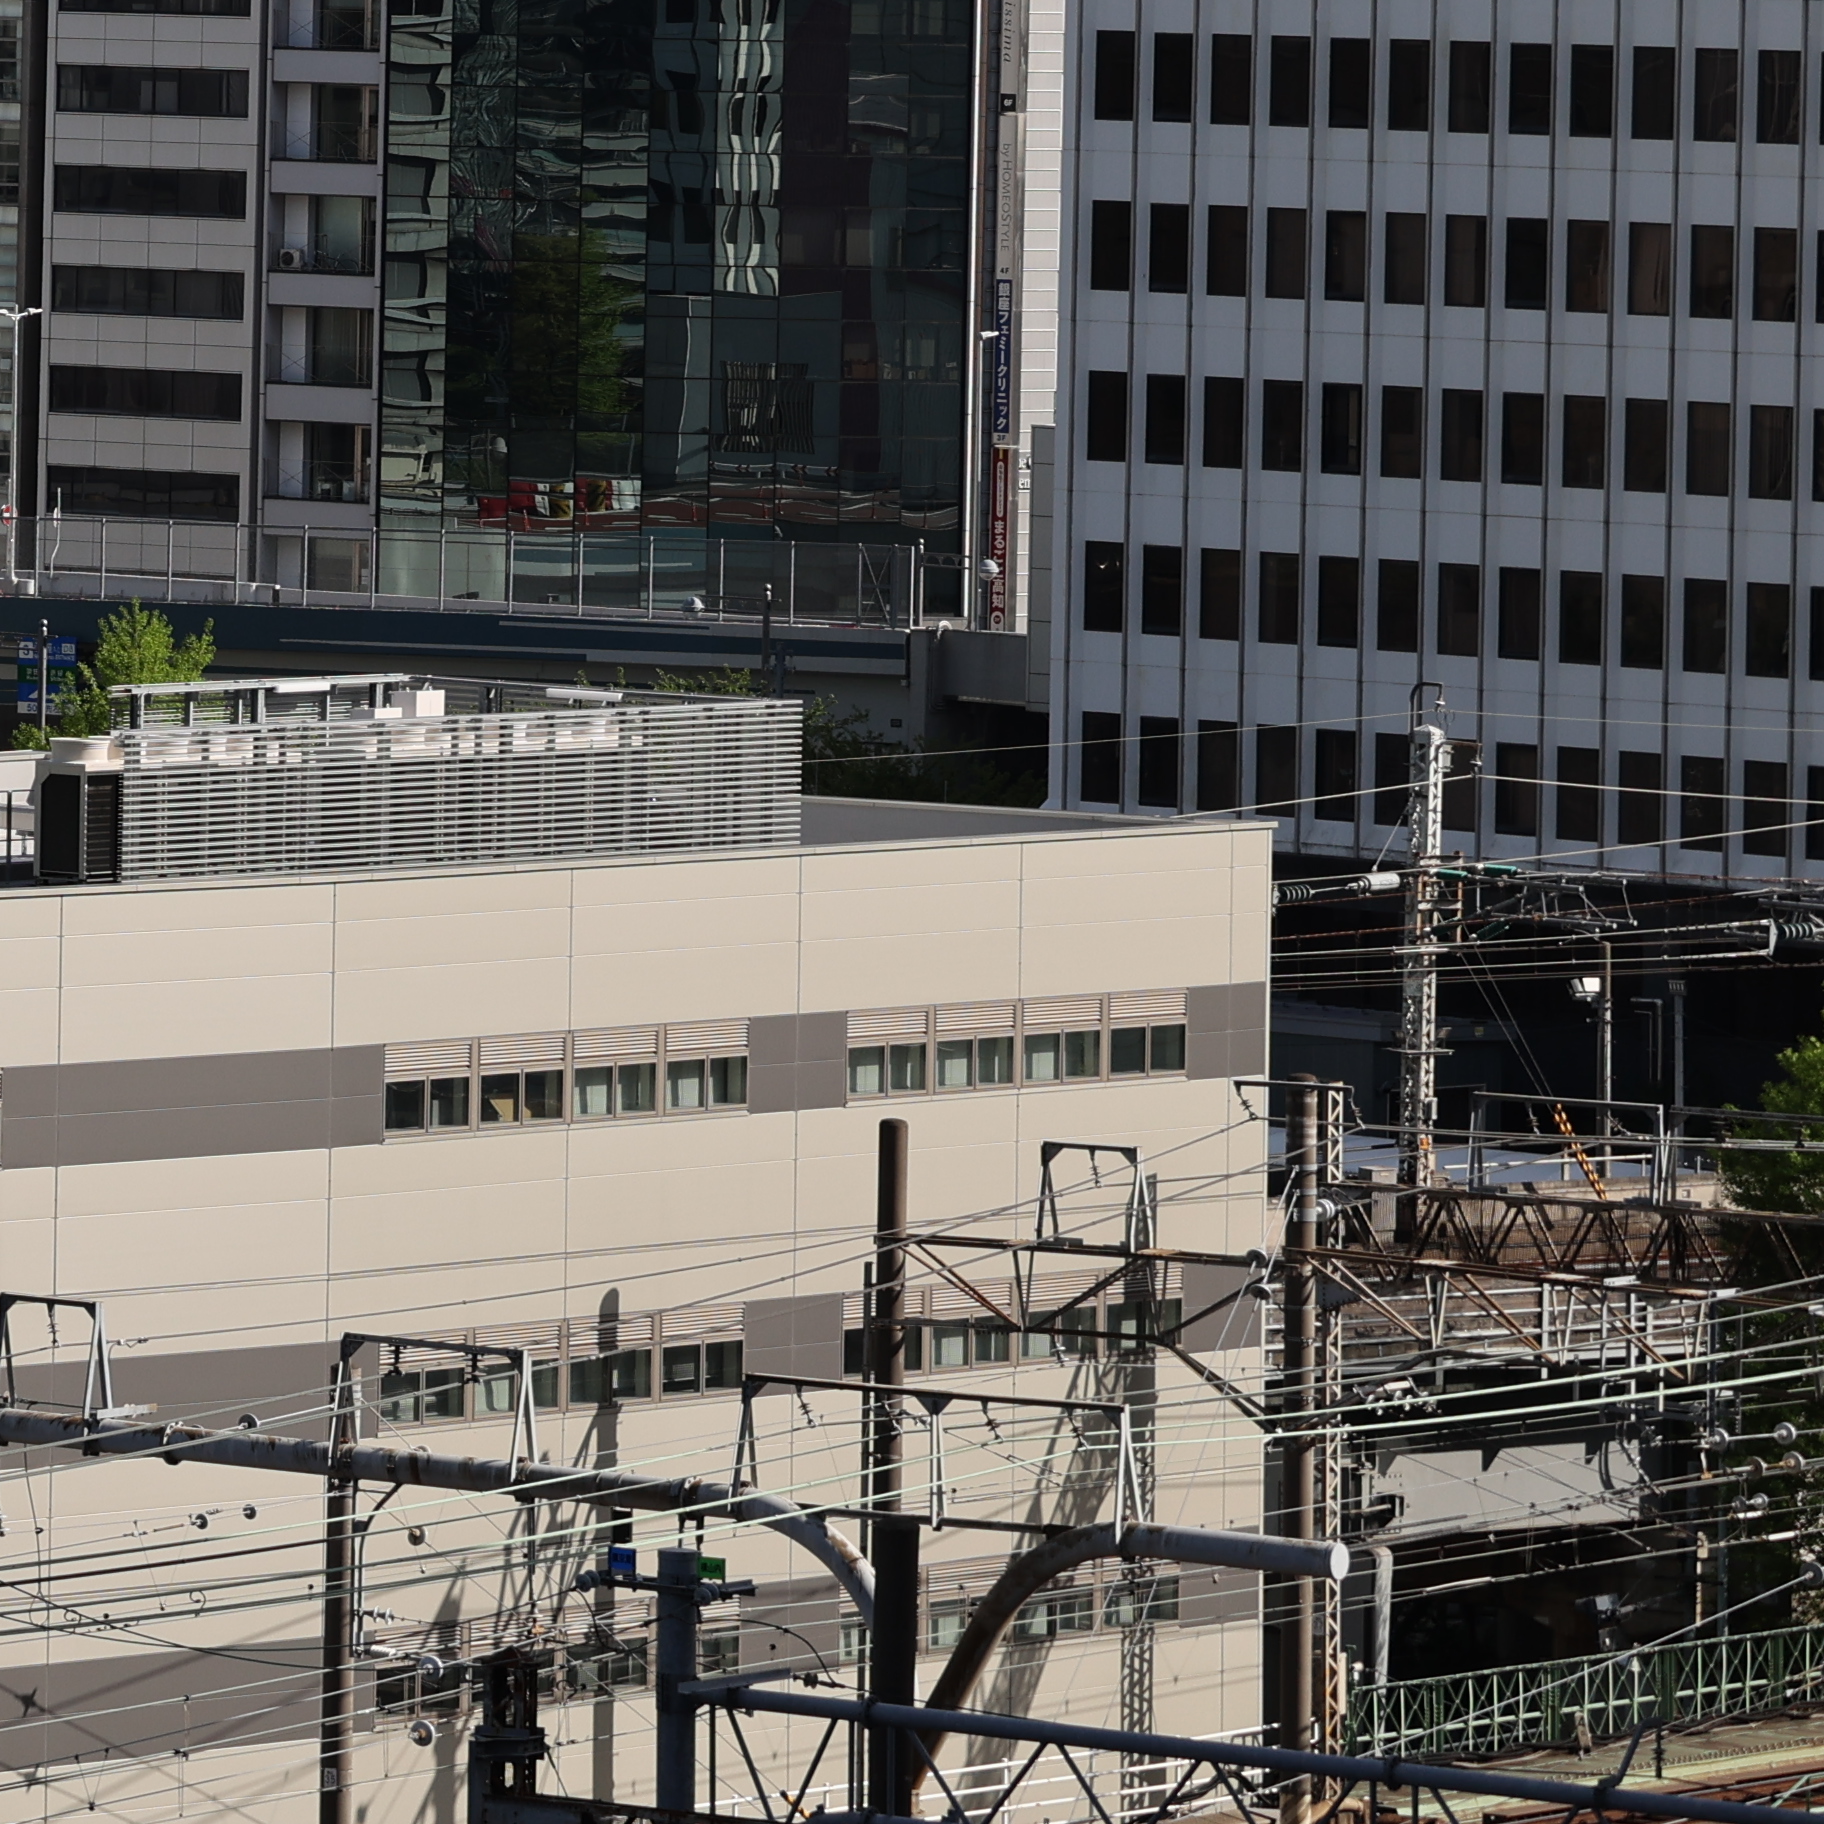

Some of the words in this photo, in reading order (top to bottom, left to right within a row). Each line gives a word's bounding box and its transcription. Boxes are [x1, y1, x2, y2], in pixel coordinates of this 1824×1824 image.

[1001, 143, 1012, 157] by
[1000, 267, 1010, 275] 4F
[996, 282, 1011, 430] 銀座フェミークリニック
